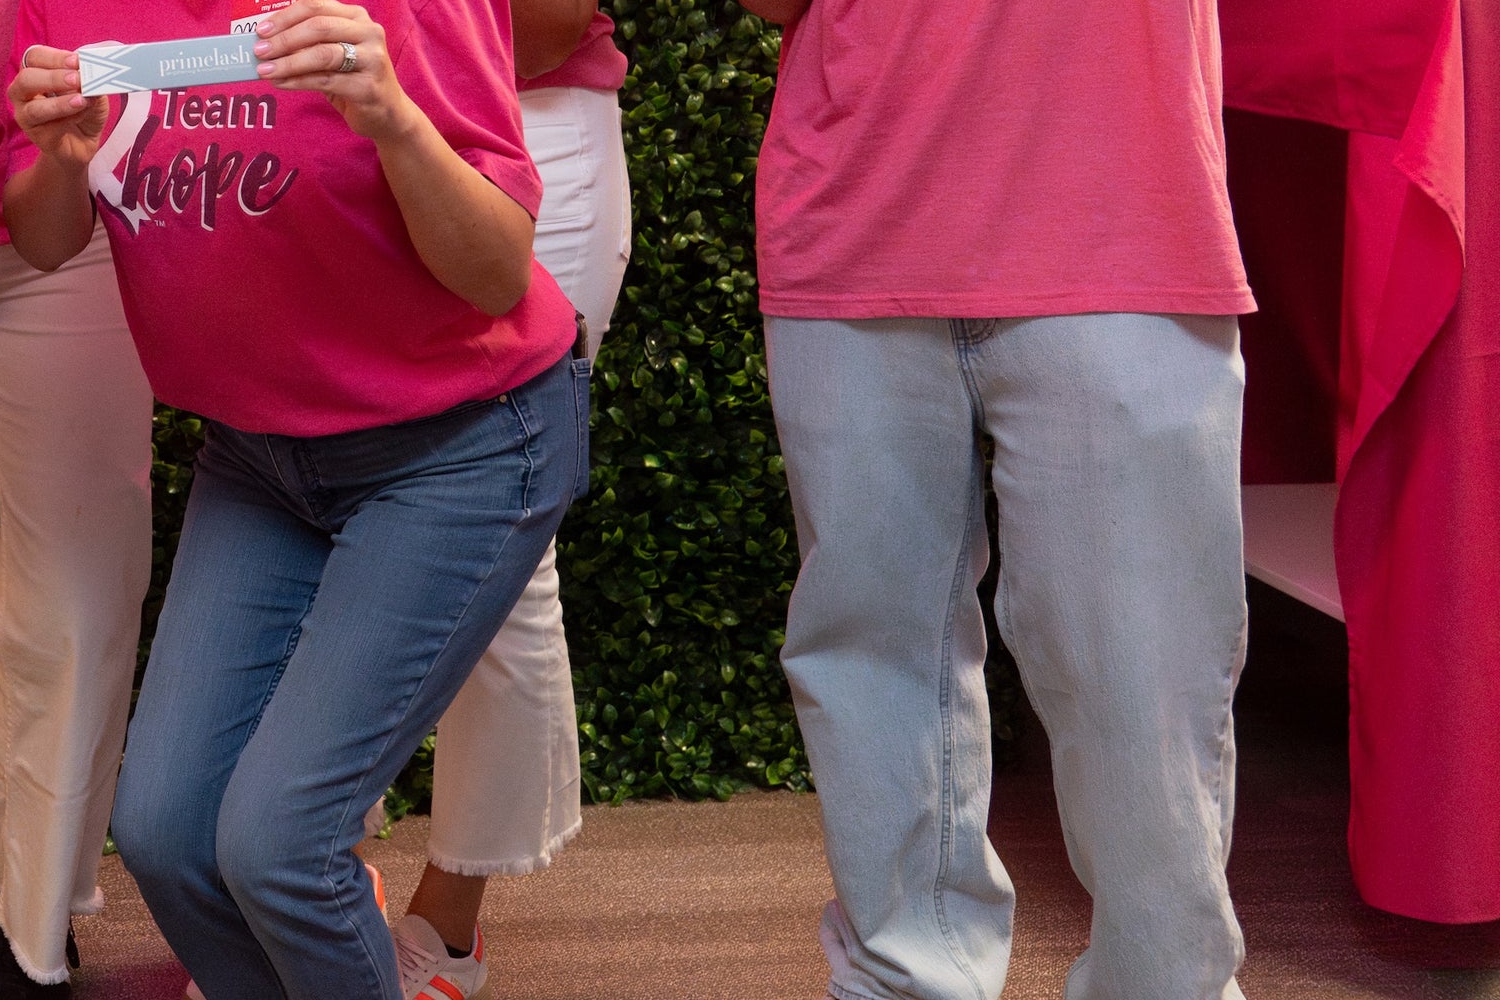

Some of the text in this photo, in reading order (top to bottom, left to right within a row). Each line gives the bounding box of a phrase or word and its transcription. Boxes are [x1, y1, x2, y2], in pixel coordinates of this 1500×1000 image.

[272, 0, 291, 9] name
[159, 45, 251, 77] primelash
[158, 87, 278, 130] Team
[119, 114, 299, 232] hope
[155, 219, 166, 227] TM
